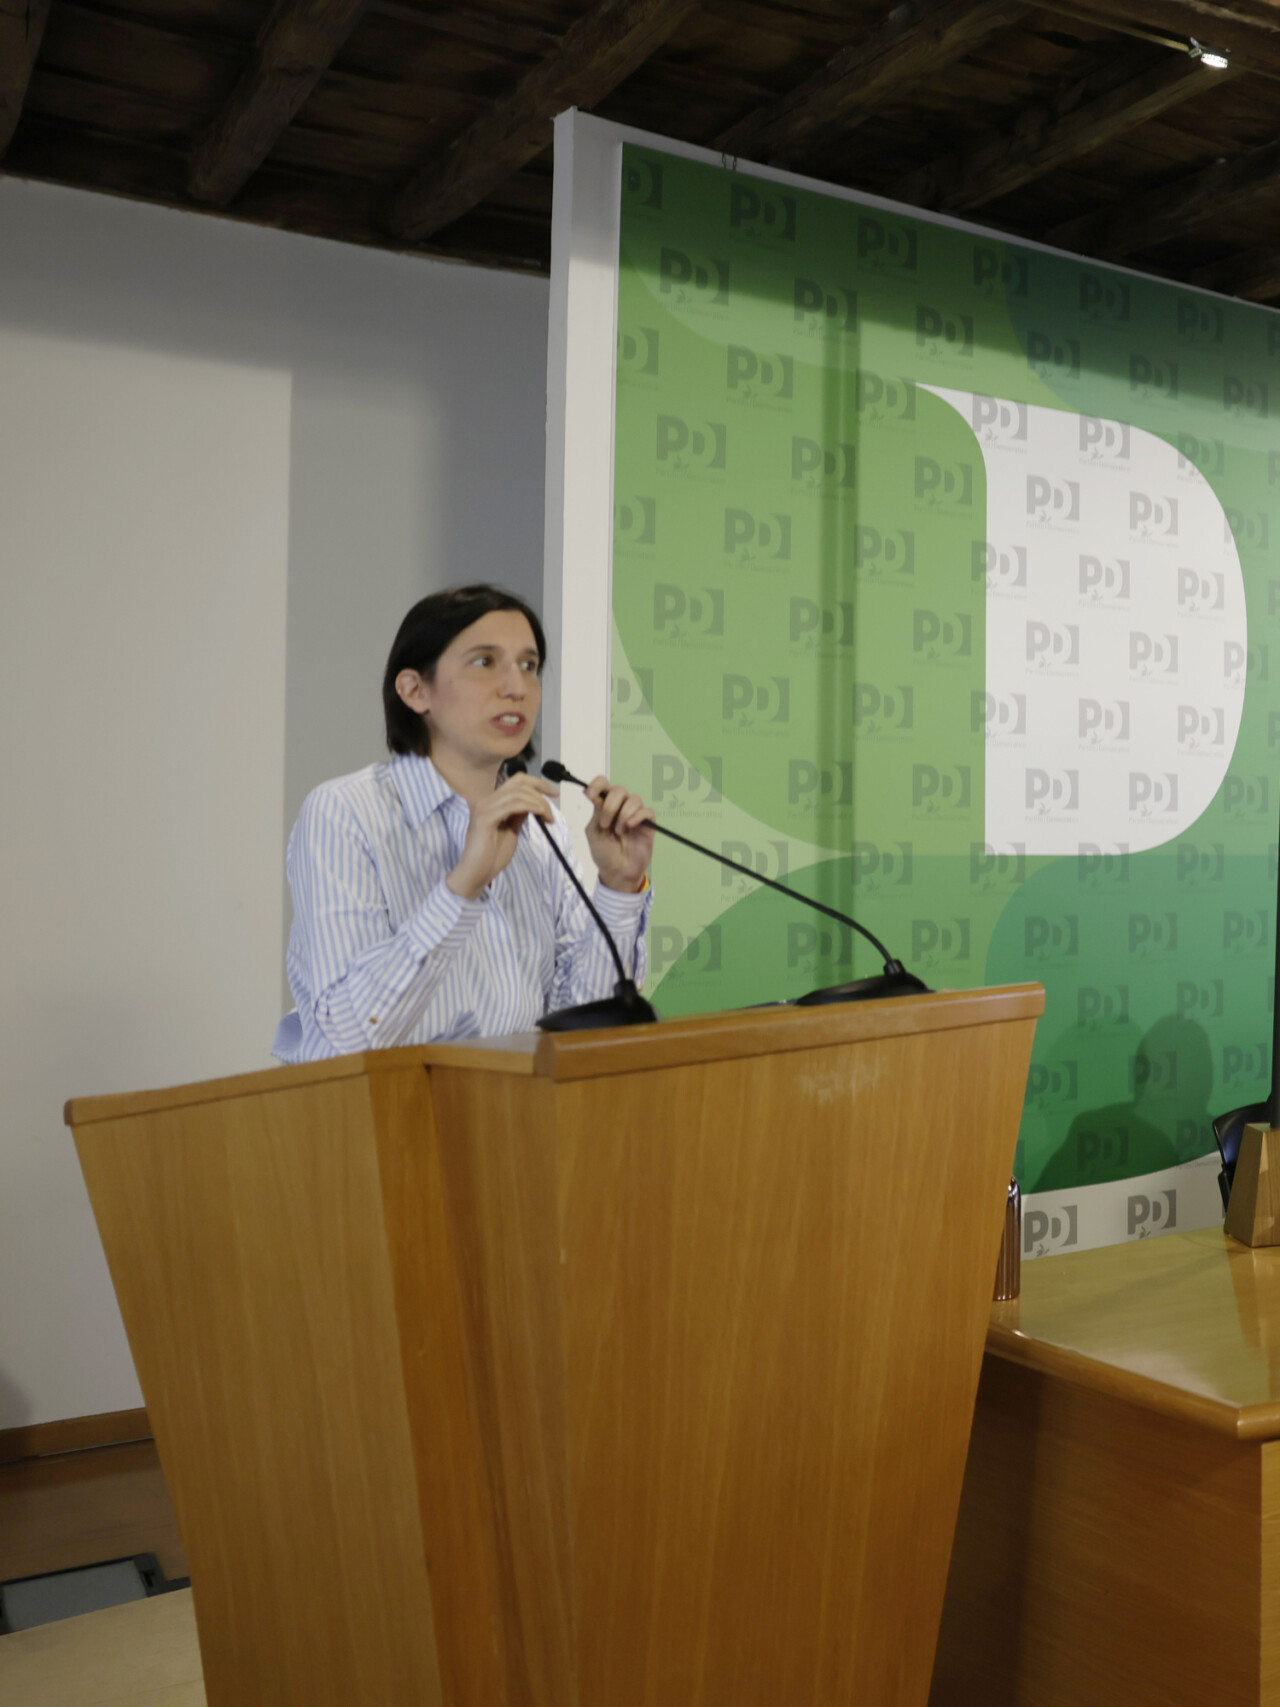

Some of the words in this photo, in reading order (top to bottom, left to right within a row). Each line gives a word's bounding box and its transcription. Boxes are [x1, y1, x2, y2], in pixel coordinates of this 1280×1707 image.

[1077, 412, 1130, 459] PD
[1176, 432, 1225, 476] PD
[1025, 475, 1080, 520] PD
[1128, 491, 1179, 535] PD
[1077, 554, 1130, 598] PD
[1176, 568, 1225, 609] PD
[1025, 621, 1080, 664] PD
[1127, 631, 1179, 673] PD
[1077, 698, 1130, 739] PD
[1176, 705, 1225, 744] PD
[1024, 768, 1080, 809] PD
[1127, 772, 1178, 811] PD
[1024, 1204, 1078, 1252] PD
[1125, 1189, 1177, 1234] PD
